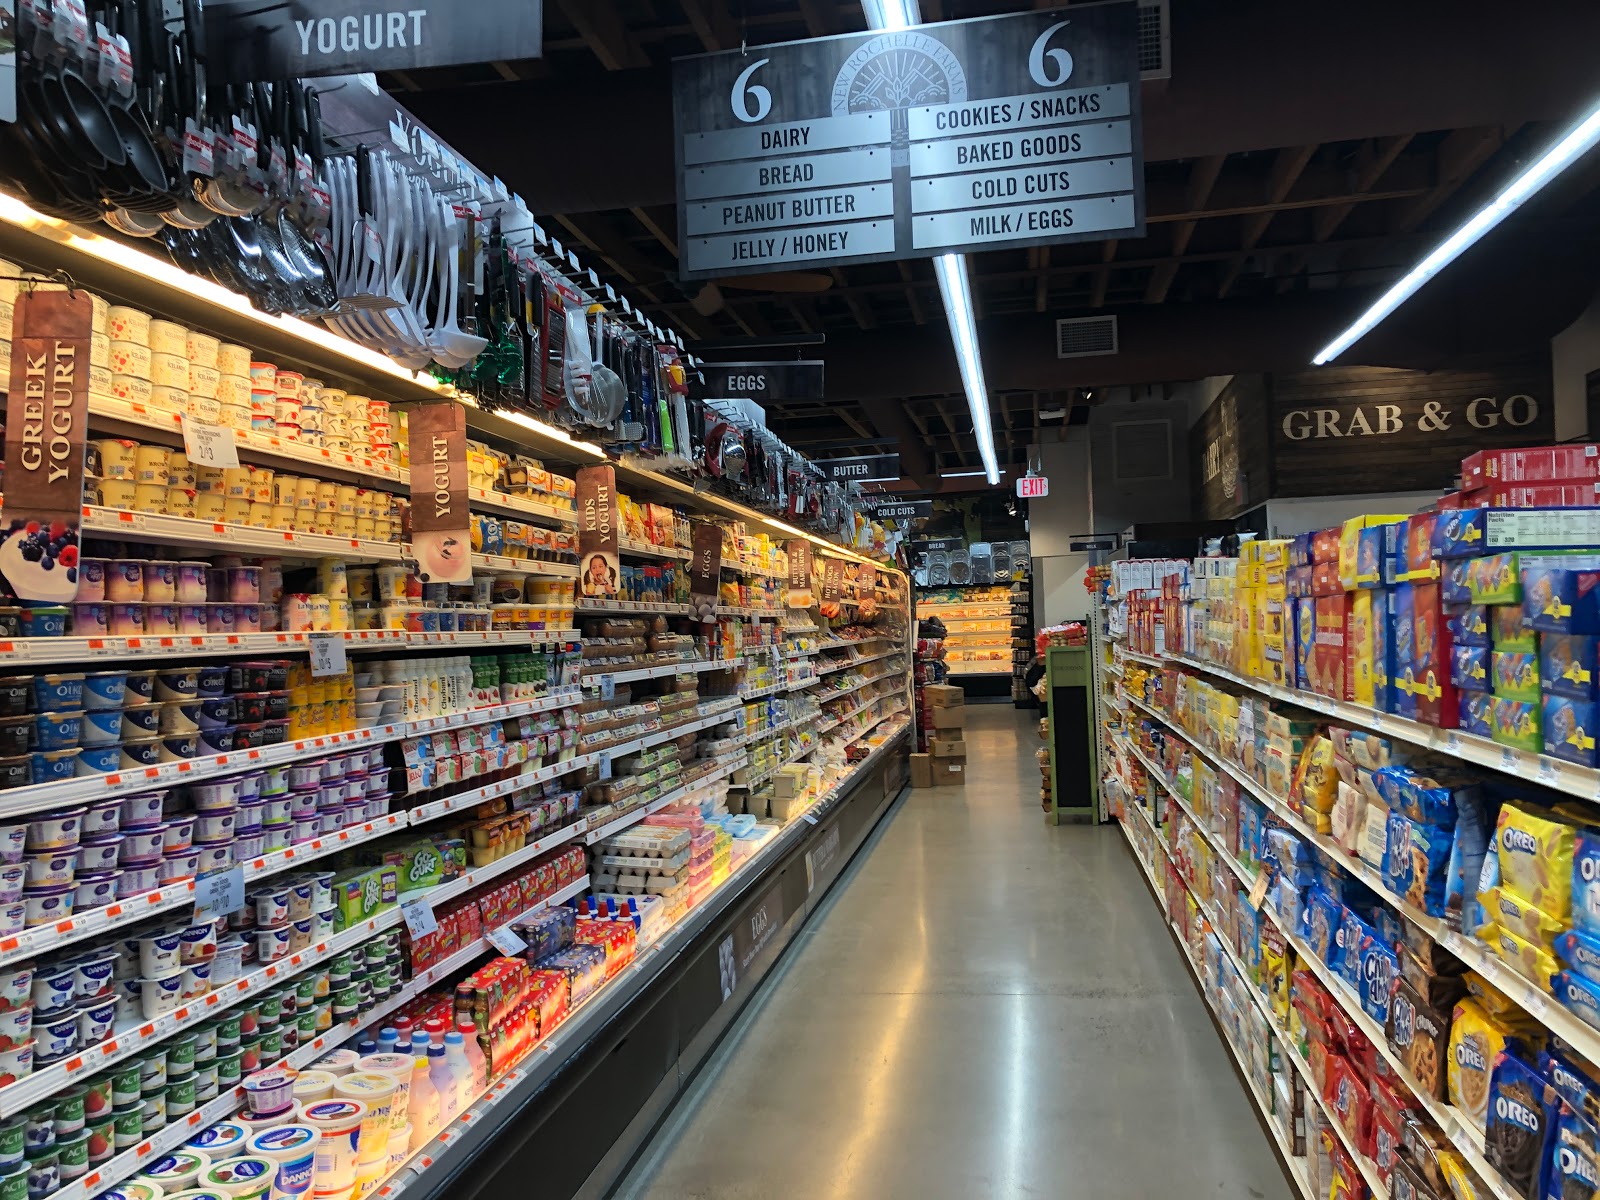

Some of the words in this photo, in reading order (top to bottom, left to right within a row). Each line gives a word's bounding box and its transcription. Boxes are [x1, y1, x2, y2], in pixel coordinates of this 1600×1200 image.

[296, 10, 427, 56] YOGURT
[1028, 20, 1074, 88] 6
[834, 75, 850, 112] NEW
[849, 34, 934, 72] ROCHELLE
[933, 45, 966, 96] FARMS
[730, 58, 772, 123] 6
[936, 104, 1012, 130] COOKIES
[1017, 100, 1025, 122] /
[1031, 93, 1100, 120] SNACKS
[761, 127, 811, 150] DAIRY
[956, 140, 1013, 164] BAKED
[1020, 133, 1082, 158] GOODS
[759, 163, 814, 186] BREAD
[972, 177, 1018, 200] COLD
[1024, 171, 1070, 194] CUTS
[722, 204, 786, 226] PEANUT
[792, 195, 856, 218] BUTTER
[970, 213, 1012, 236] MILK
[1016, 212, 1024, 232] /
[1028, 208, 1074, 230] EGGS
[732, 238, 776, 261] JELLY
[780, 237, 788, 258] /
[793, 231, 848, 254] HONEY
[728, 374, 766, 392] EGGS
[21, 352, 48, 471] GREEK
[48, 341, 76, 484] YOGURT
[1282, 404, 1404, 440] GRAB
[1417, 401, 1452, 433] &
[1466, 394, 1538, 429] GO
[432, 436, 451, 519] YOGURT
[834, 464, 868, 476] BUTTER
[1022, 478, 1044, 496] EXIT
[585, 498, 596, 532] KIDS
[598, 484, 612, 544] YOGURT
[878, 508, 896, 517] COLD
[897, 506, 916, 516] CUTS
[928, 542, 946, 550] BREAD
[701, 549, 712, 579] EGGS
[1502, 828, 1536, 851] OREO
[1581, 857, 1600, 881] OR
[1568, 984, 1598, 1008] OREO
[1456, 1045, 1486, 1070] OREO
[1554, 1068, 1584, 1092] OREO
[1496, 1096, 1538, 1132] OREO
[1560, 1146, 1598, 1185] OREO
